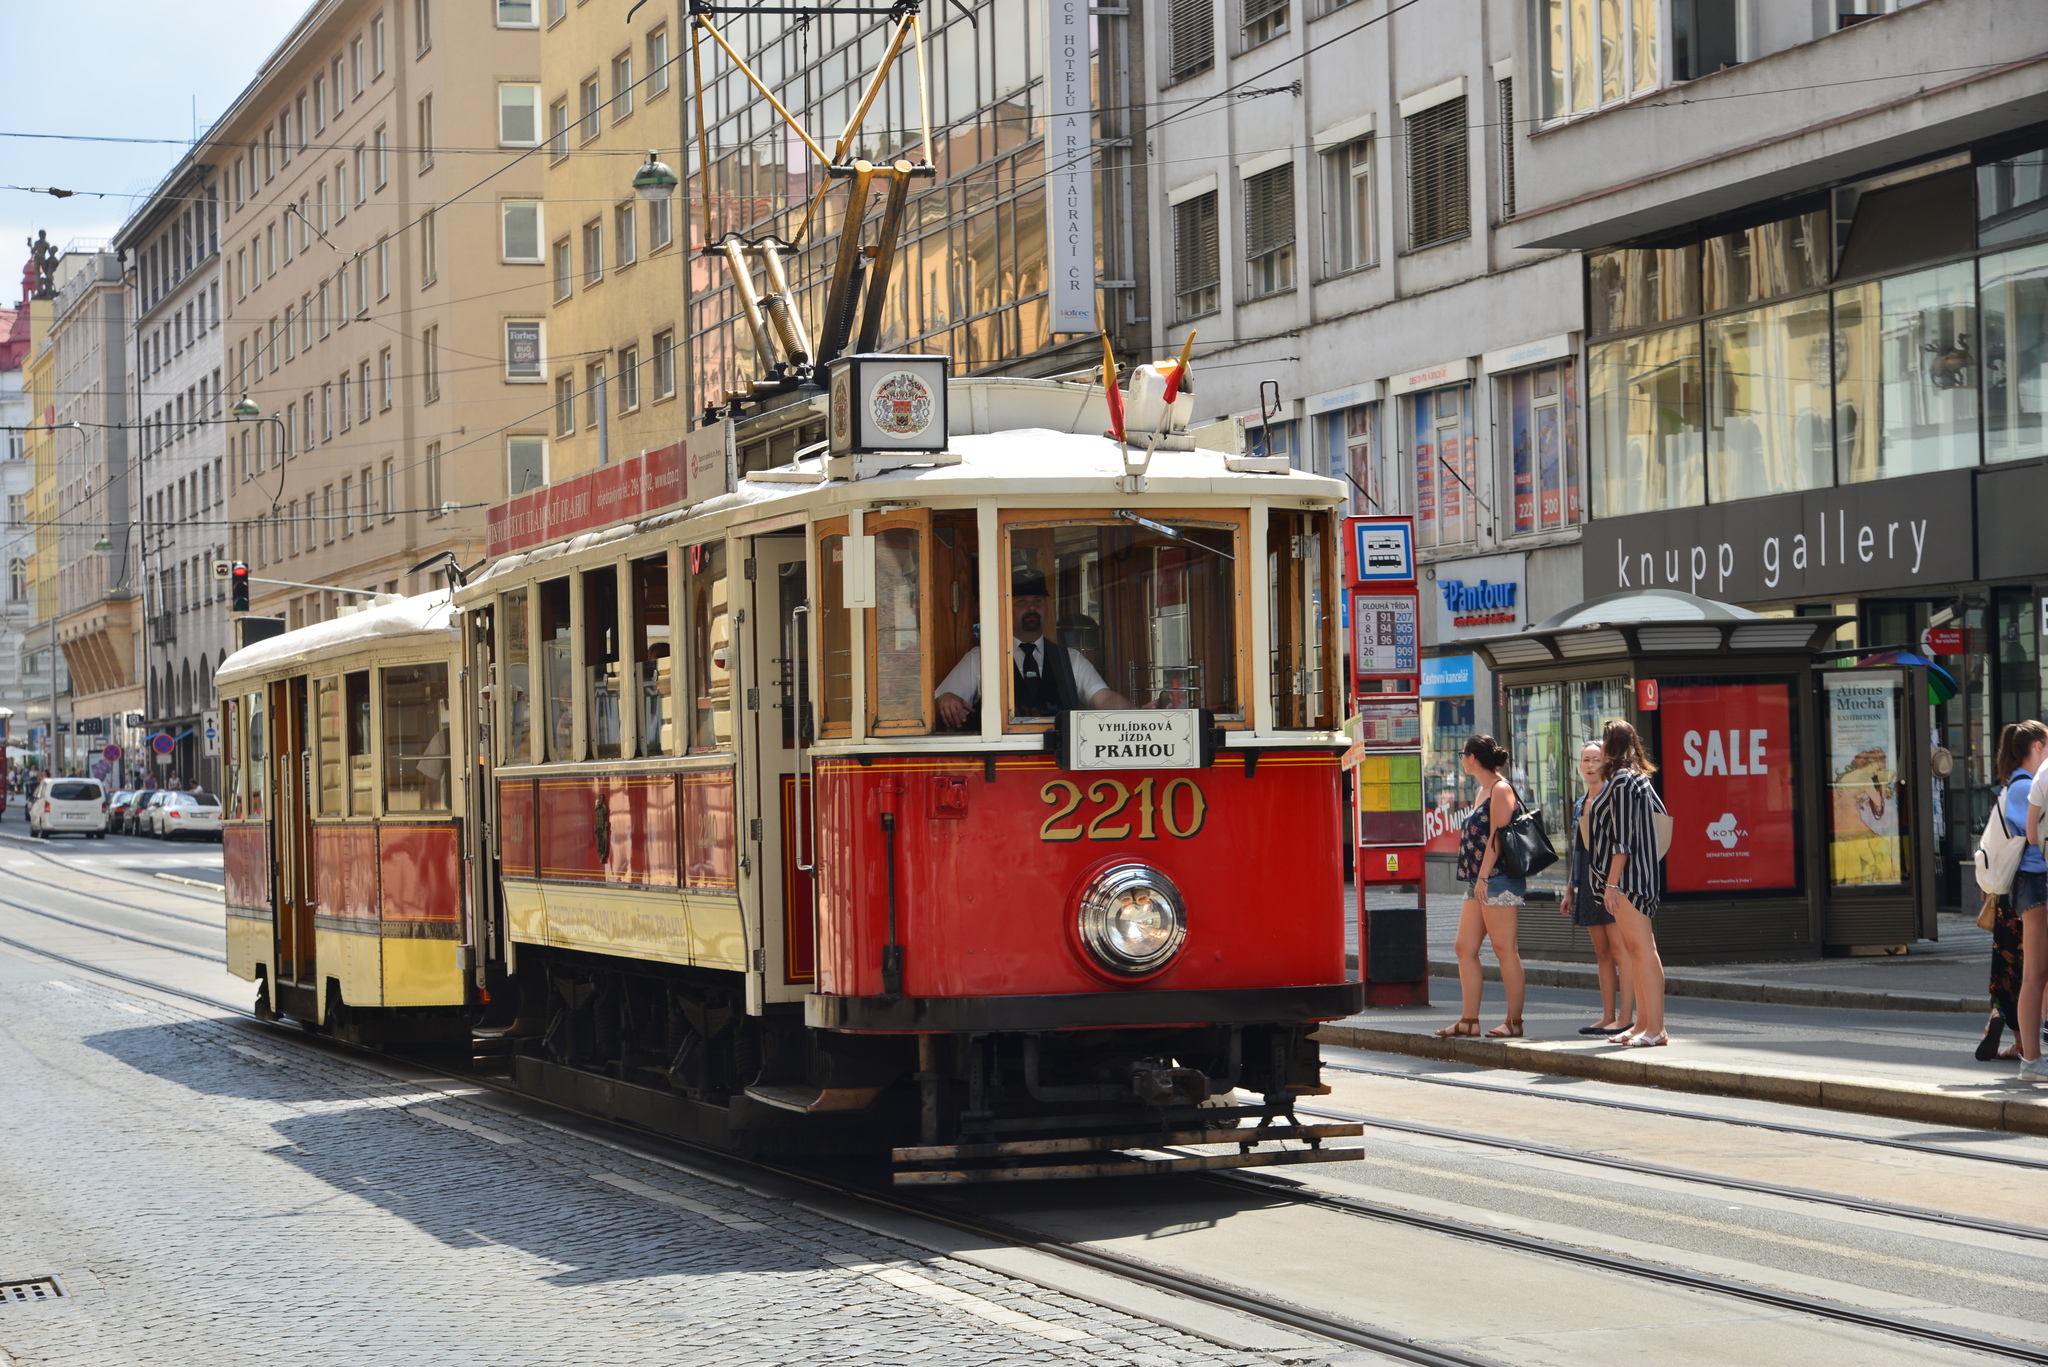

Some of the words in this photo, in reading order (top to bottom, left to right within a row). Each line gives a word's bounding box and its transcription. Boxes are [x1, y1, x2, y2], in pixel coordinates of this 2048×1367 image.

[1064, 35, 1076, 107] HOTELŮ
[1066, 117, 1077, 127] A
[1066, 135, 1079, 256] RESTAURACÍ
[1069, 266, 1081, 291] ČR
[510, 331, 538, 340] Forbes
[1408, 371, 1427, 386] cestovní
[1427, 365, 1447, 383] kancelář
[560, 491, 589, 523] PRAHOU
[1519, 502, 1534, 519] 222
[1544, 498, 1559, 515] 300
[1617, 538, 1734, 595] knupp
[1763, 509, 1927, 588] gallery
[1446, 580, 1518, 612] Pantour
[1362, 601, 1389, 610] DLOUHÁ
[1390, 601, 1410, 610] TŘÍDA
[1365, 612, 1371, 621] 6
[1380, 612, 1391, 621] 91
[1396, 612, 1412, 621] 207
[1365, 624, 1371, 633] 8
[1380, 624, 1392, 633] 94
[1396, 623, 1413, 633] 905
[1363, 636, 1374, 645] 15
[1380, 635, 1392, 645] 96
[1396, 635, 1413, 645] 907
[1363, 647, 1374, 656] 26
[1396, 647, 1414, 656] 909
[1363, 659, 1374, 668] 41
[1396, 658, 1413, 668] 911
[1423, 670, 1445, 685] Cestovní
[1445, 668, 1469, 683] kancelář
[1836, 684, 1883, 697] Alfons
[1836, 697, 1885, 711] Mucha
[1837, 714, 1881, 722] EXHIBITION
[1098, 720, 1173, 732] VYHLÍDKOVÁ
[1118, 731, 1152, 742] JÍZDA
[1095, 744, 1175, 758] PRAHOU
[1683, 729, 1768, 777] SALE
[1040, 777, 1208, 843] 2210
[1425, 802, 1450, 841] RST
[698, 813, 718, 848] 2210
[1712, 829, 1749, 837] KOTVA
